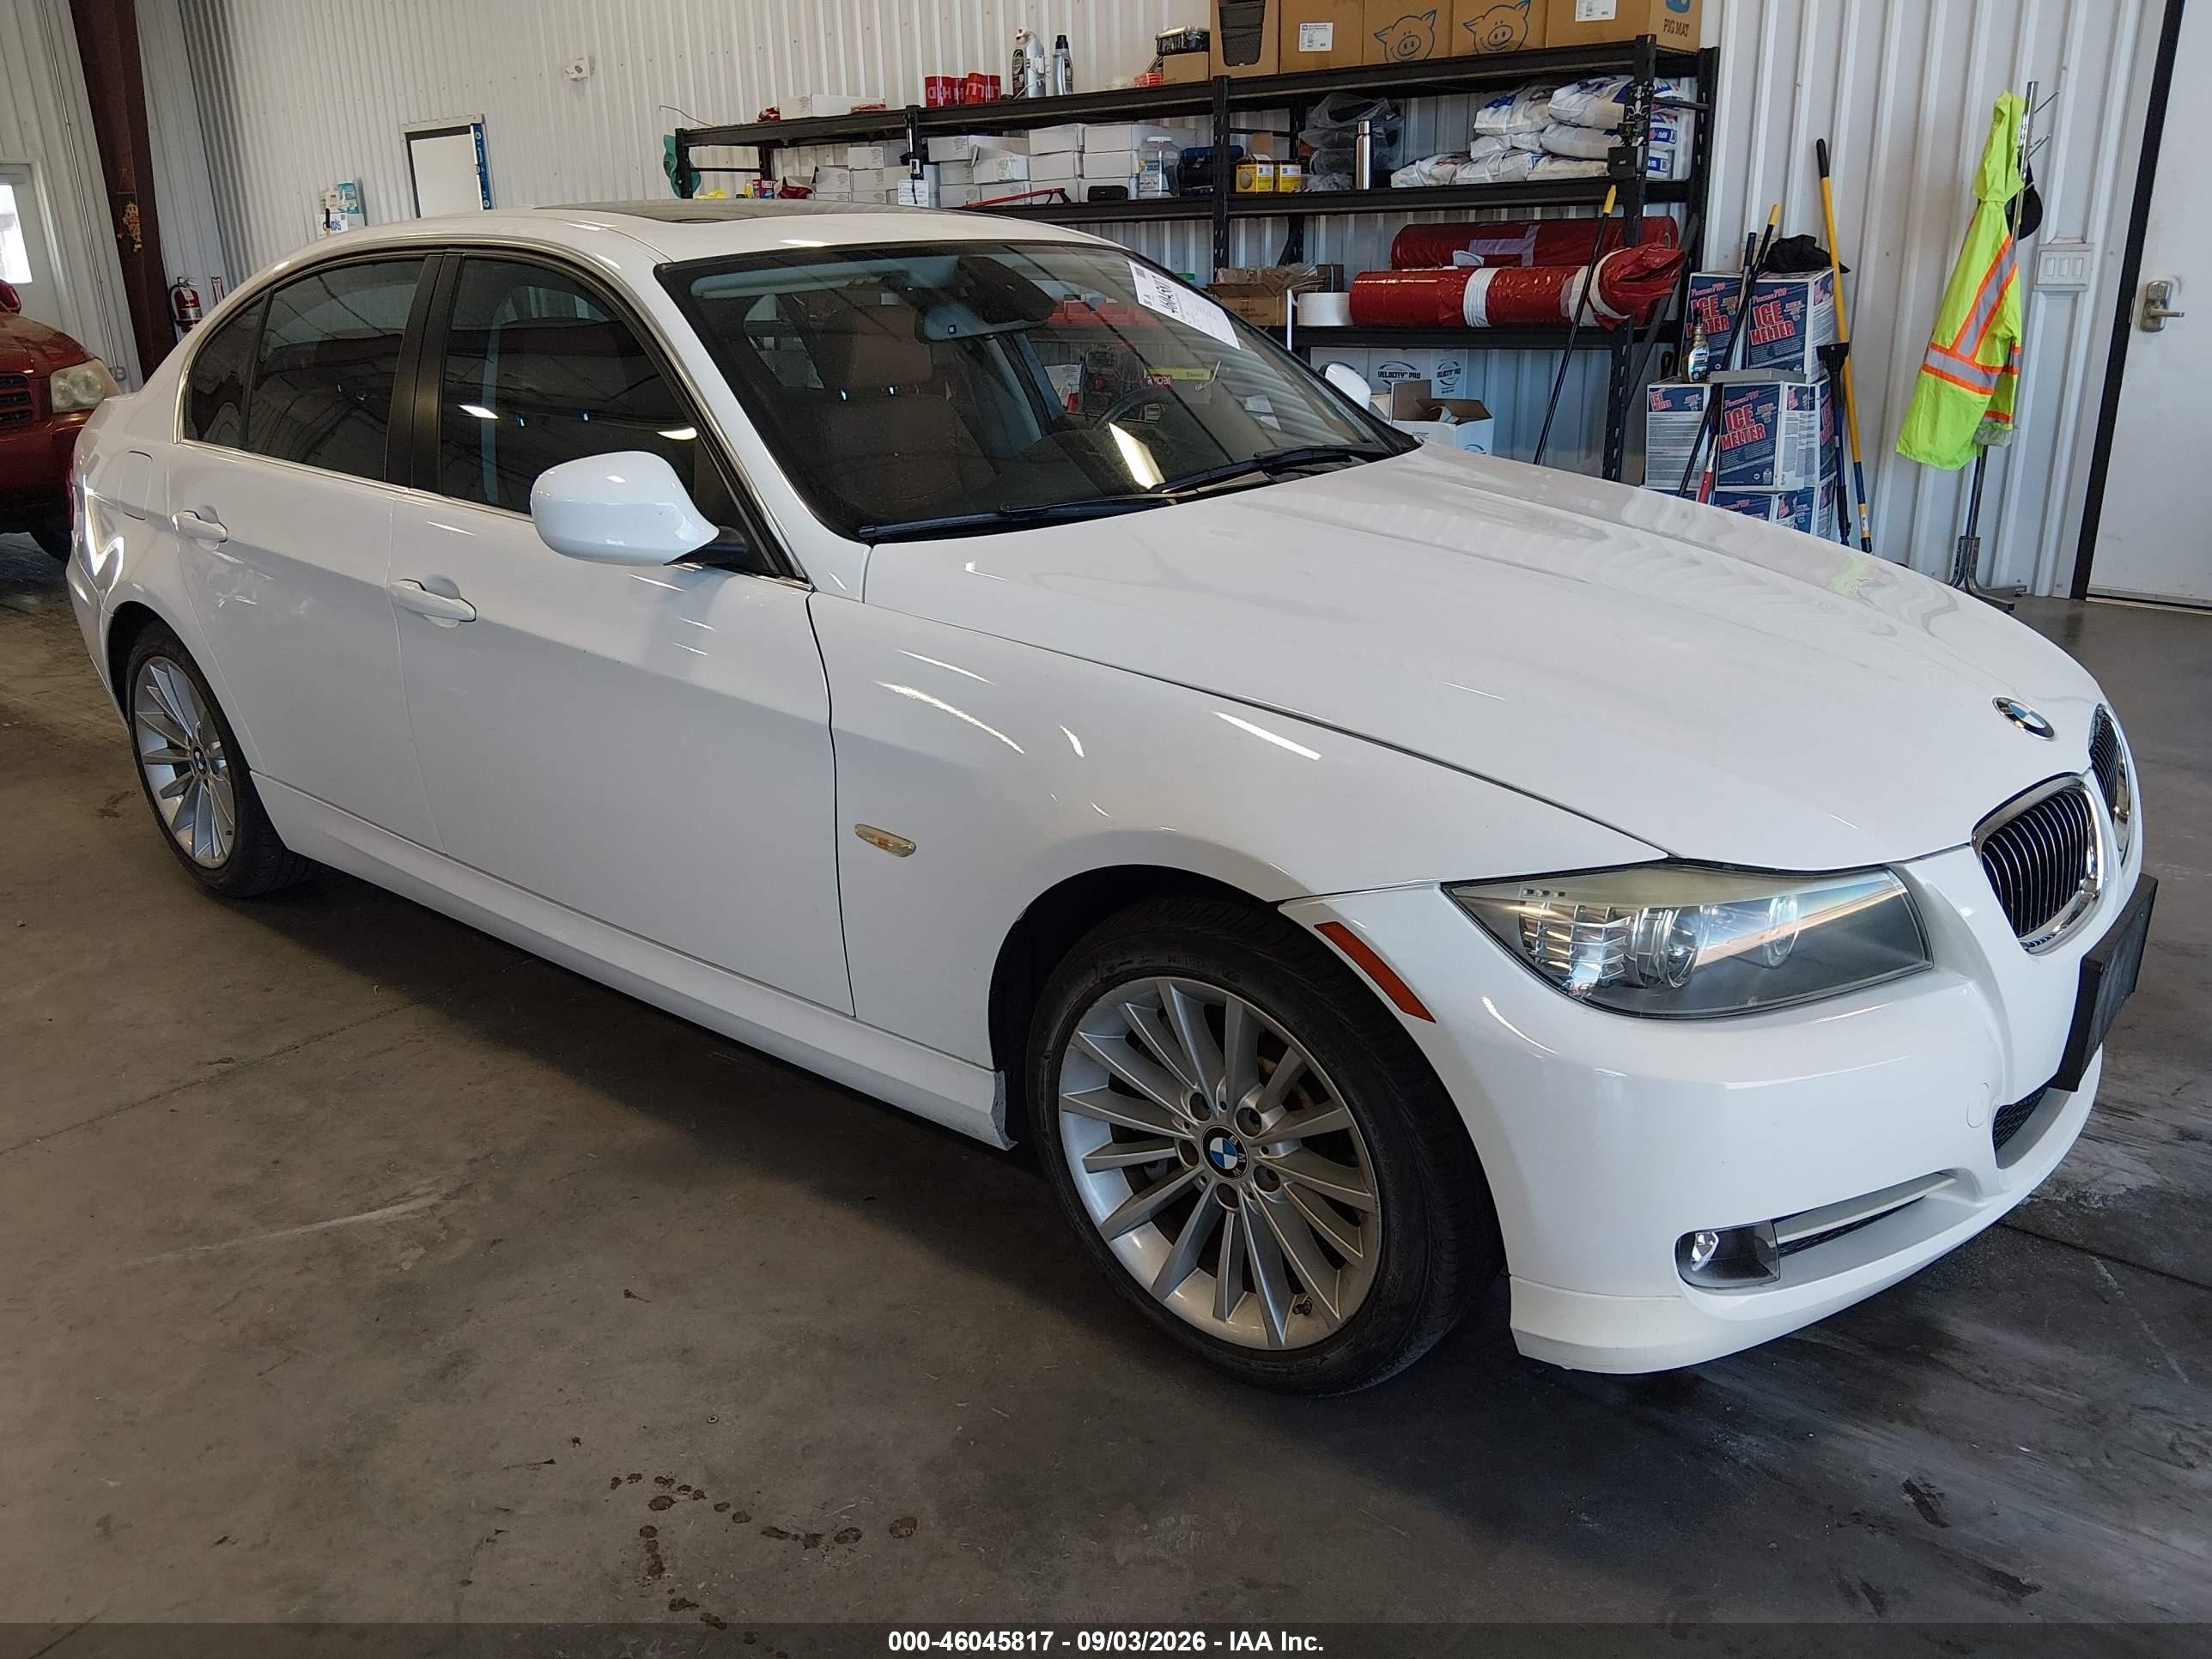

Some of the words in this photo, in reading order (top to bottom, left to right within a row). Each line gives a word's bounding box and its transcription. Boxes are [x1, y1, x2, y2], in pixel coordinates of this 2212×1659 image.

[1663, 18, 1674, 34] PIG
[1675, 21, 1690, 37] MAT
[1753, 301, 1784, 328] ICE
[1749, 320, 1796, 345] MELTER
[1147, 376, 1171, 386] RYOBI
[1408, 371, 1421, 380] PRO
[1724, 404, 1755, 433] ICE
[1721, 423, 1766, 451] MELTER
